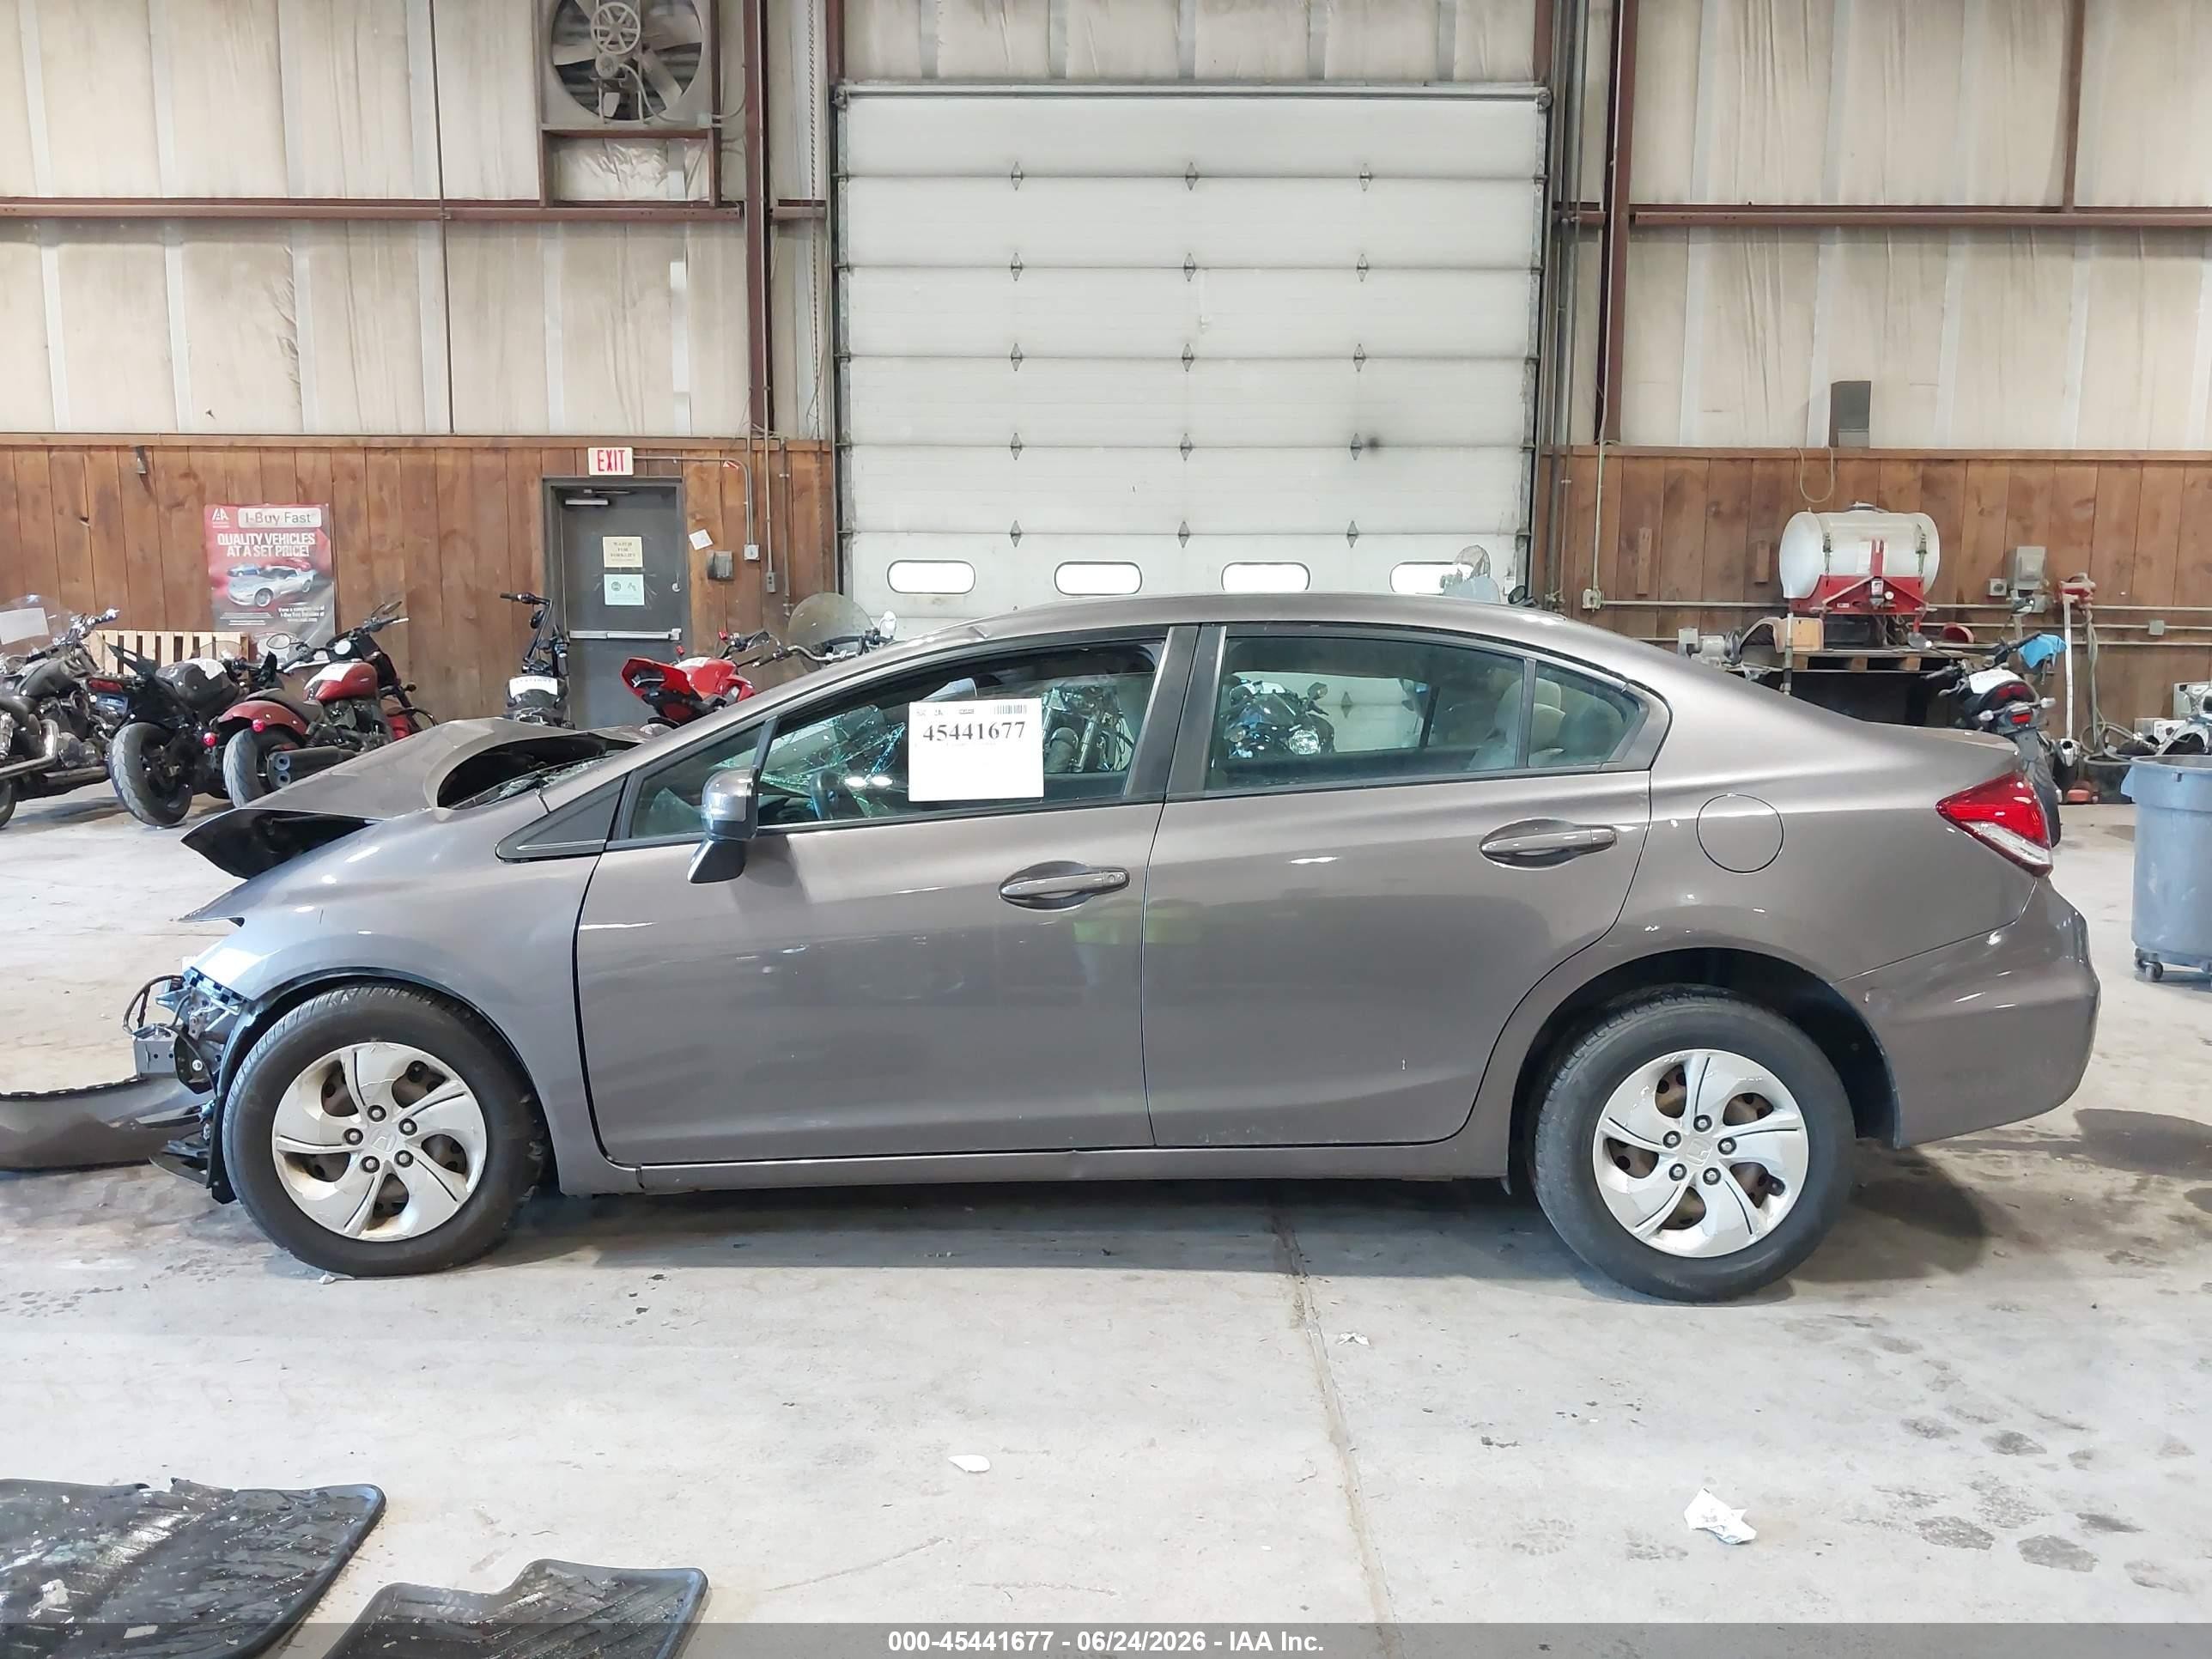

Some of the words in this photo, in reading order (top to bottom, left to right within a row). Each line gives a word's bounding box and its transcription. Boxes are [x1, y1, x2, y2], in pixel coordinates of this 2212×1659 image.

[597, 449, 626, 472] EXIT
[245, 512, 280, 526] I-Buy
[284, 512, 312, 523] Fast
[217, 532, 263, 545] QUALITY
[264, 532, 316, 545] VEHICLES
[227, 545, 241, 557] AT
[243, 545, 252, 557] A
[253, 545, 274, 557] SET
[275, 545, 310, 557] PRICE!
[922, 721, 1026, 741] 45441677
